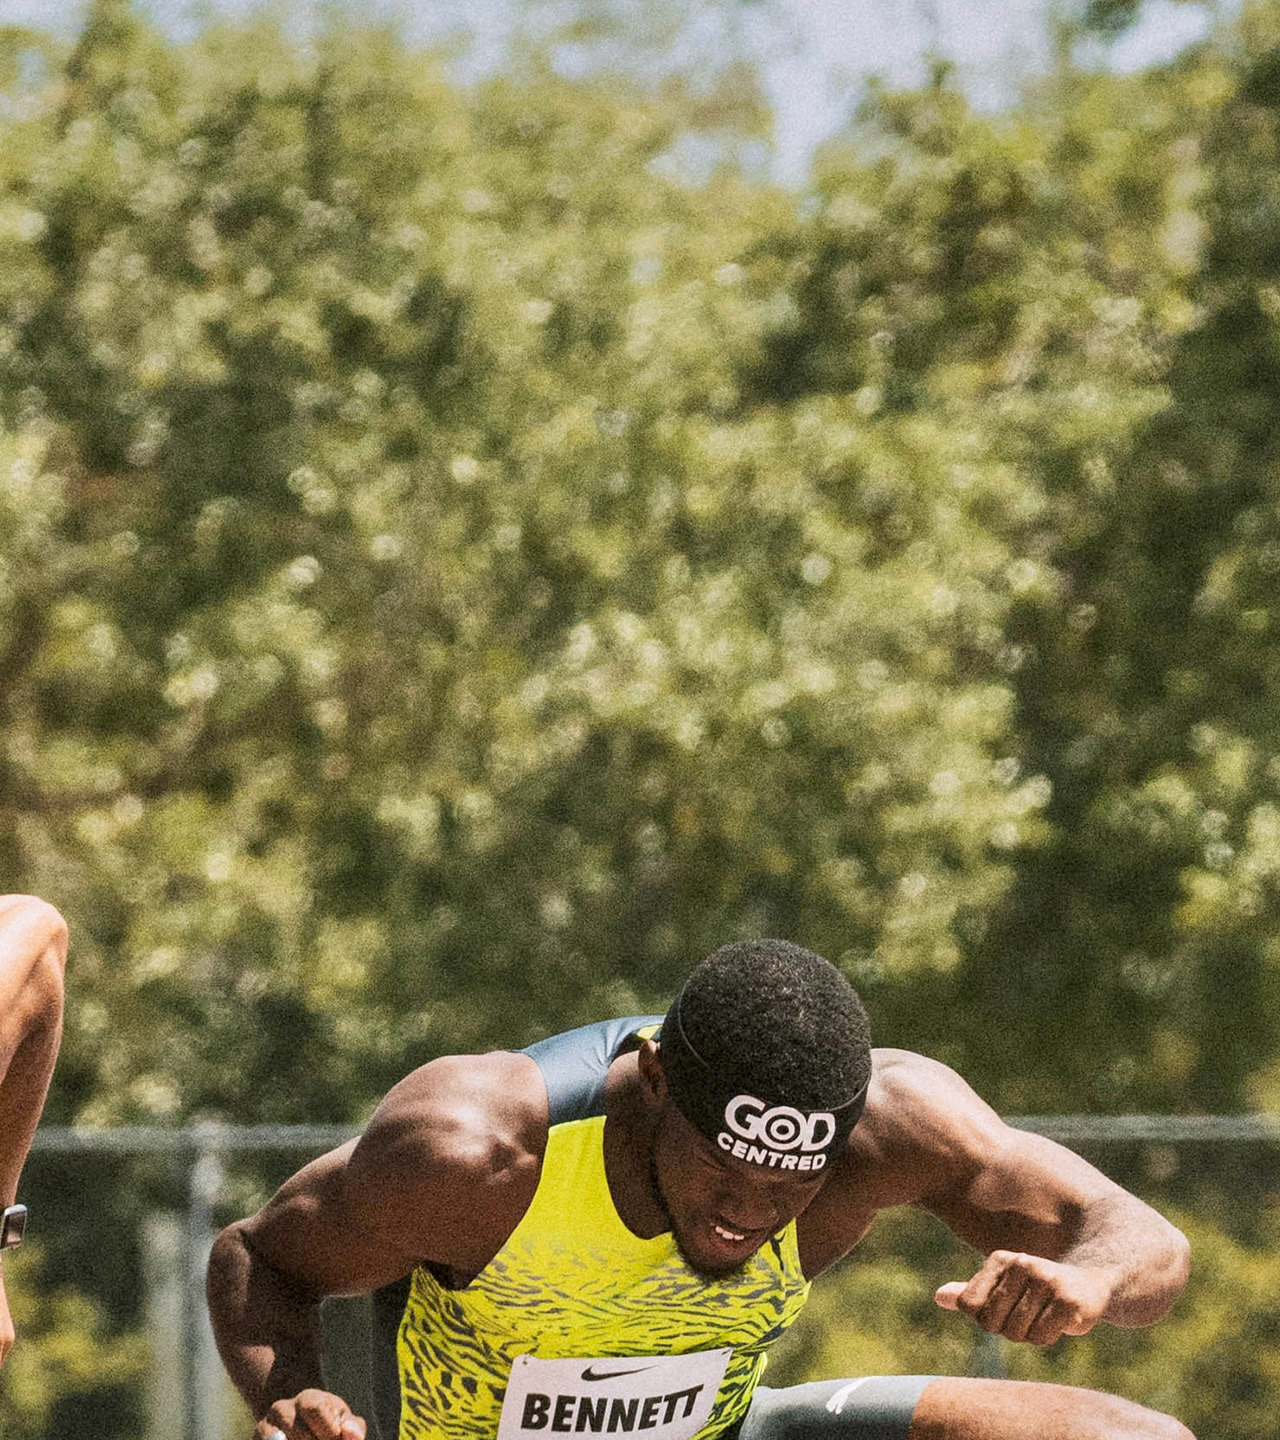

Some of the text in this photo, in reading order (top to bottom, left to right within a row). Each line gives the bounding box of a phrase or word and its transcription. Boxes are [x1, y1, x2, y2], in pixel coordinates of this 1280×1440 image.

[724, 1094, 836, 1152] GOD
[717, 1132, 827, 1171] CENTRED
[520, 1384, 704, 1433] BENNETT
